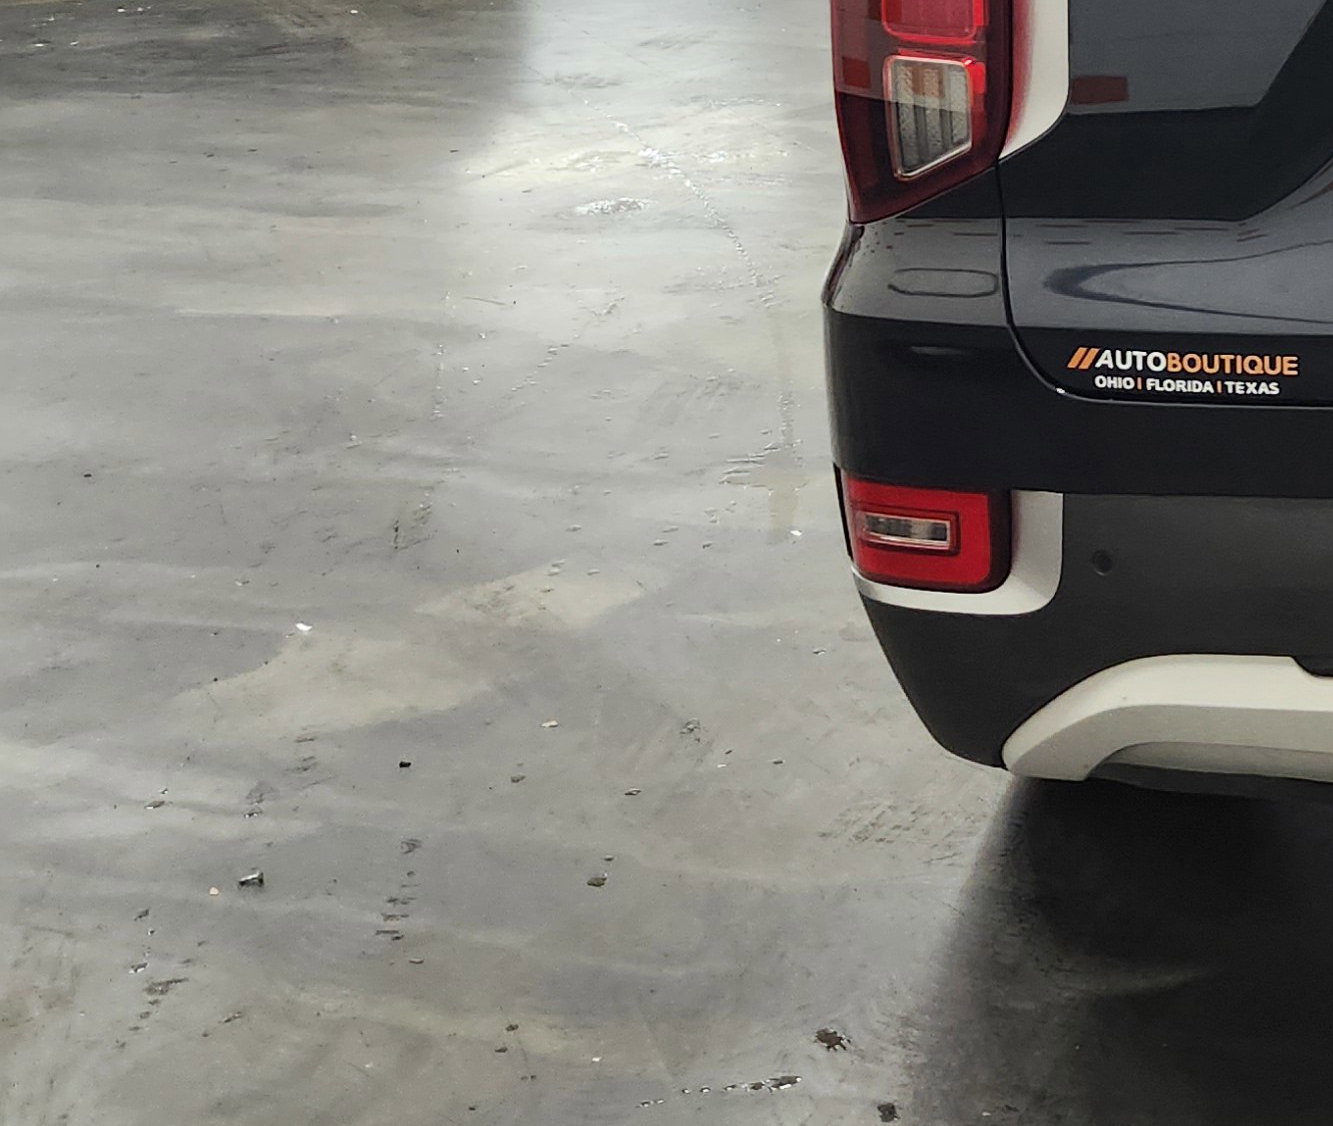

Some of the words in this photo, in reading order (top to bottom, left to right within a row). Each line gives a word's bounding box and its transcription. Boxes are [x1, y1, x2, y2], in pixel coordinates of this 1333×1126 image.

[1094, 348, 1299, 376] AUTOBOUTIQUE
[1094, 375, 1135, 390] OHIO
[1145, 377, 1215, 394] FLORIDA
[1223, 380, 1281, 395] TEXAS
